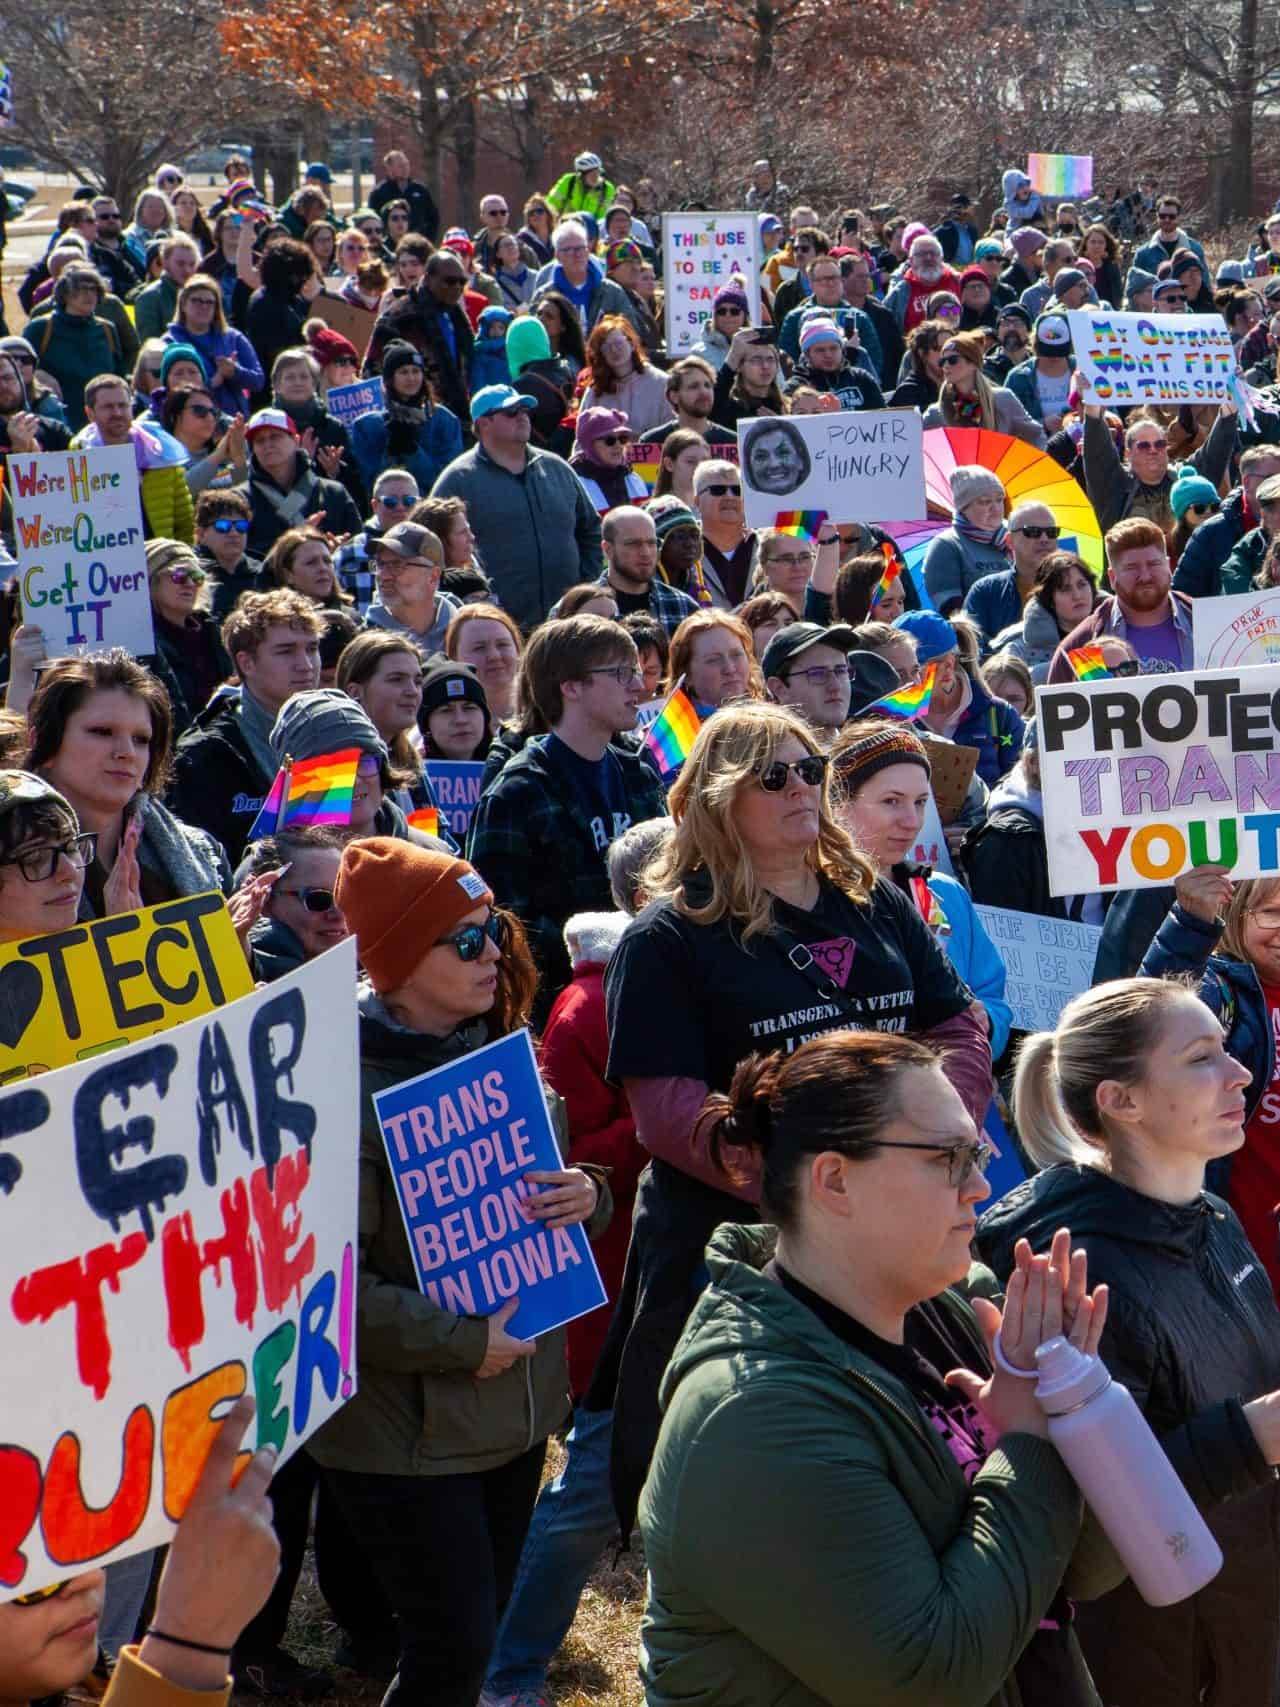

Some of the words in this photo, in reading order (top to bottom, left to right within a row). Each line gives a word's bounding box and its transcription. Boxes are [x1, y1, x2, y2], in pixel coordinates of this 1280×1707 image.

[672, 233, 710, 247] THIS
[715, 231, 746, 246] USE
[674, 261, 694, 274] TO
[702, 261, 722, 274] BE
[730, 260, 740, 274] A
[1184, 352, 1231, 374] FIT
[827, 418, 909, 445] POWER
[827, 454, 911, 482] HUNGRY
[65, 600, 112, 646] IT
[428, 776, 482, 804] TRAN
[1038, 919, 1099, 954] BIBLE
[1034, 951, 1072, 986] BE
[381, 1069, 511, 1164] TRANS
[399, 1117, 537, 1220] PEOPLE
[413, 1174, 545, 1274] BELON
[11, 1147, 317, 1402] THE
[425, 1269, 478, 1316] IN
[477, 1226, 583, 1306] IOWA
